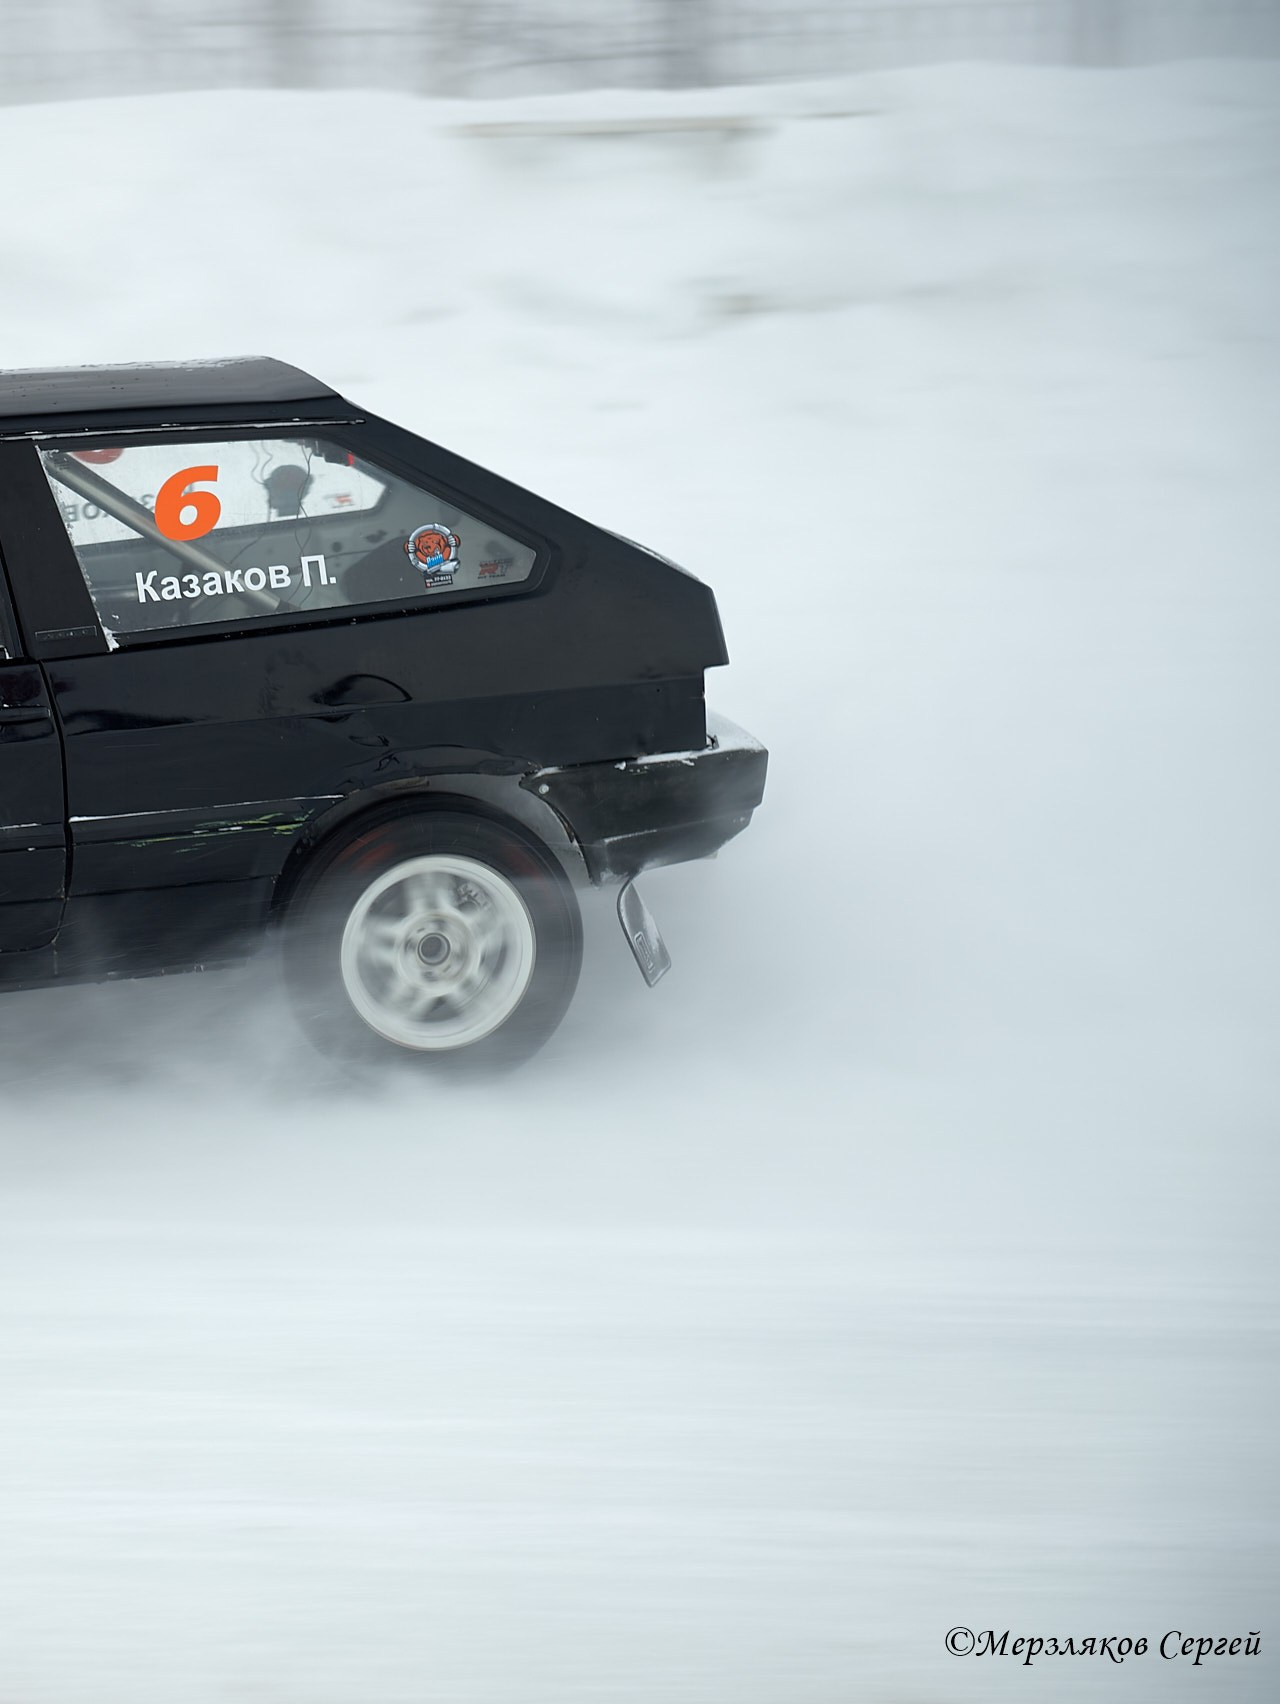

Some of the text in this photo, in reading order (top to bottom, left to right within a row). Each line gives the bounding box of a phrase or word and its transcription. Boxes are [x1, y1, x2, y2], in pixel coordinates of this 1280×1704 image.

[154, 465, 221, 541] 6
[135, 554, 337, 603] Казаков П.
